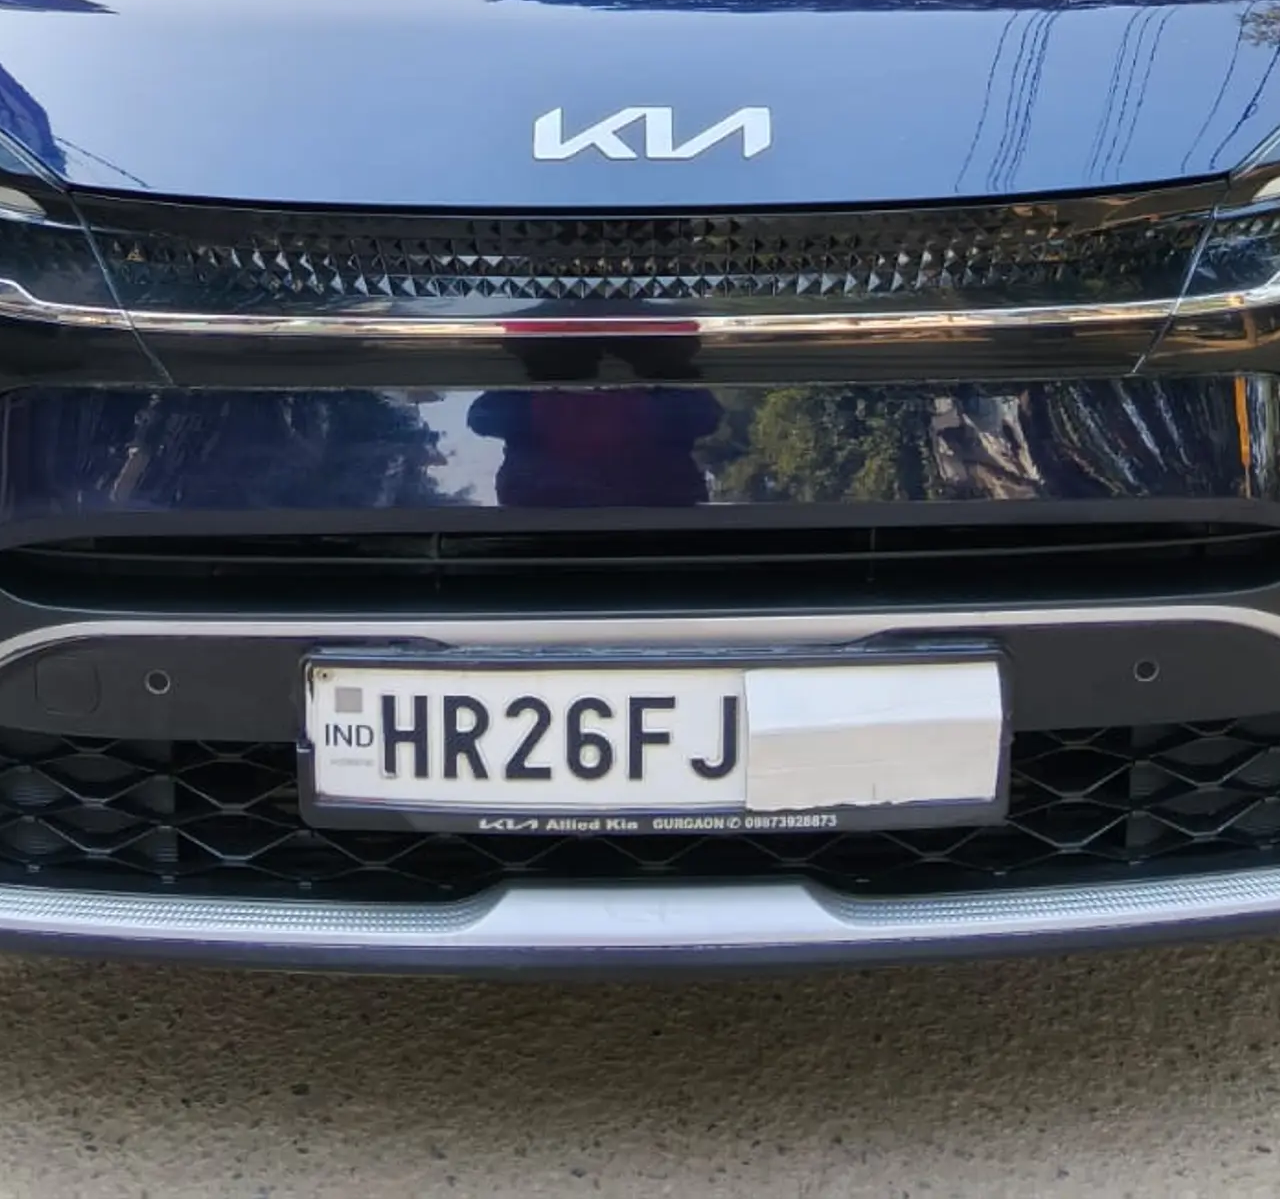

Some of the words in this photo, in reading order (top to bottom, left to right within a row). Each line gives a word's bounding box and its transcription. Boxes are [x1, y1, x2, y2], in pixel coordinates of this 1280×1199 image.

[325, 723, 375, 748] IND
[381, 694, 738, 780] HR26FJ
[546, 818, 600, 831] Allied
[606, 818, 638, 830] Kia
[652, 817, 724, 830] GURGAON
